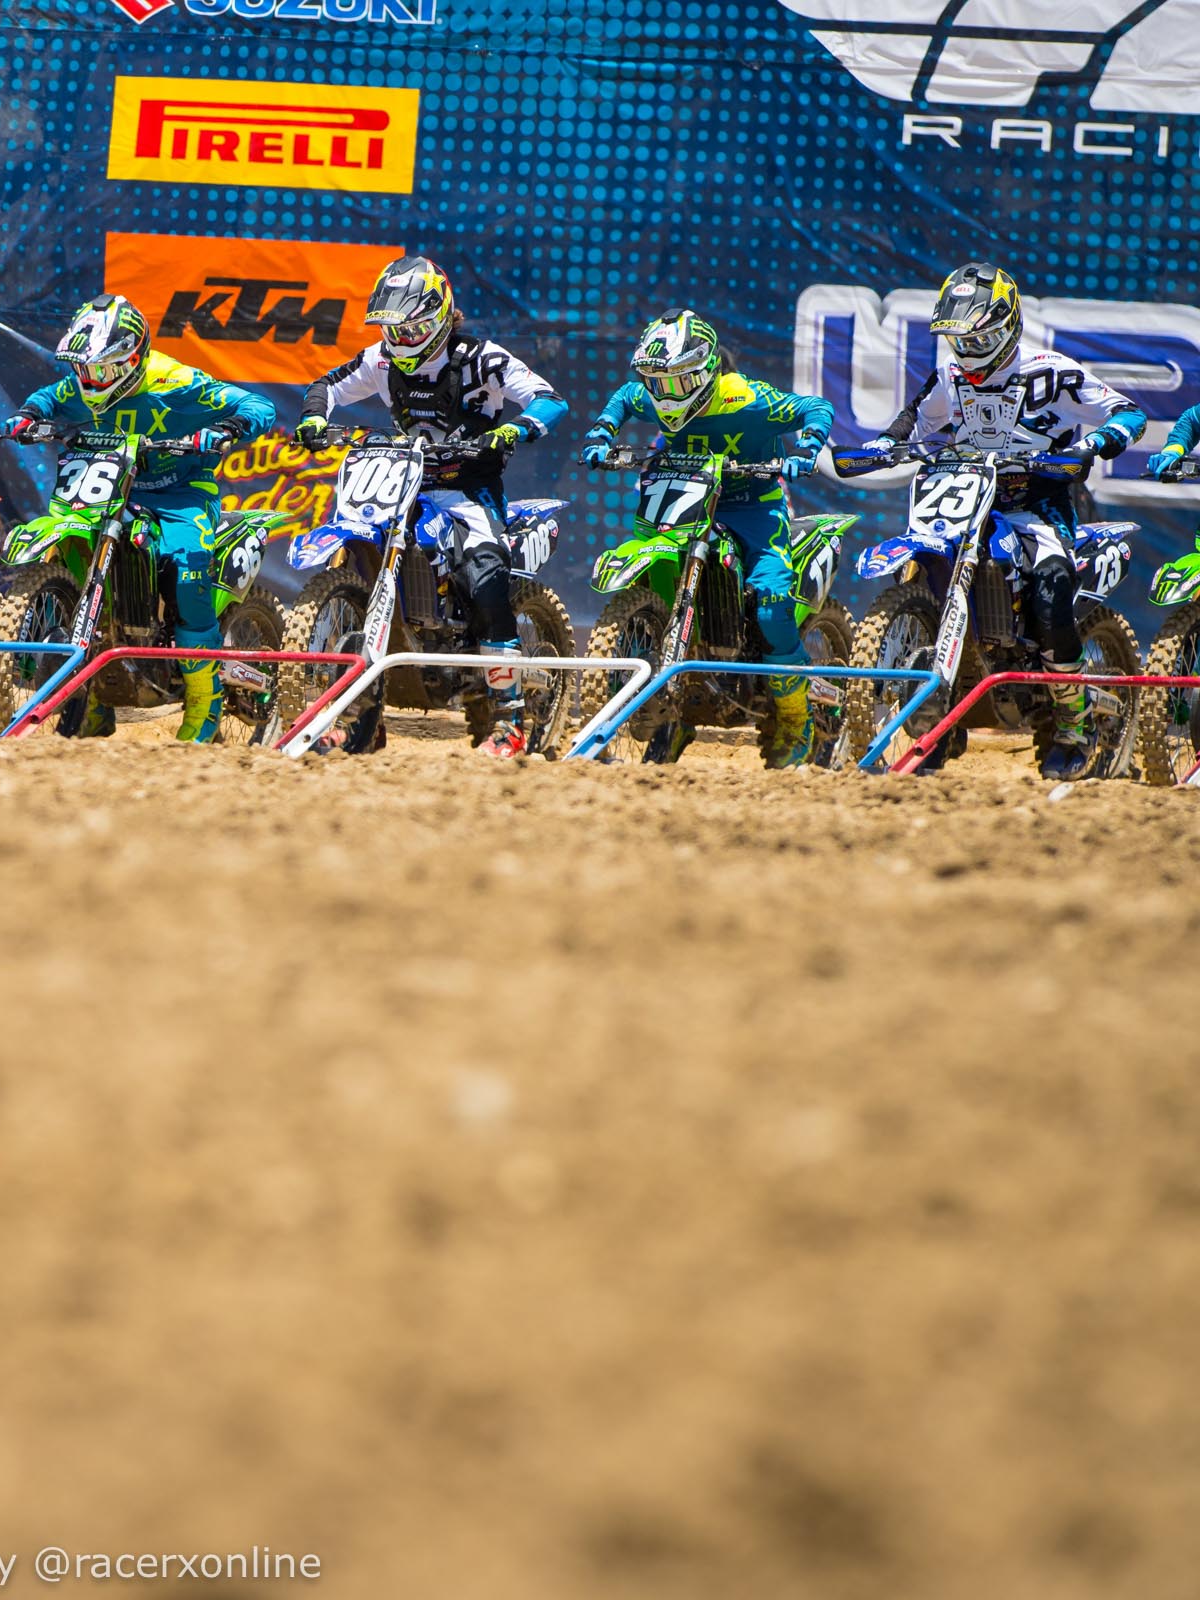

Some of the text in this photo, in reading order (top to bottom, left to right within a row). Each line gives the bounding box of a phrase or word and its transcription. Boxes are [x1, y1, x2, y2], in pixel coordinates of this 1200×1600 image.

[135, 99, 390, 169] PIRELLI
[157, 276, 348, 346] KTM
[94, 452, 107, 460] OIL
[365, 450, 398, 458] LUCAS OIL
[958, 464, 970, 473] OIL
[55, 460, 120, 504] 36
[342, 456, 417, 504] 108
[644, 479, 708, 525] 17
[914, 472, 981, 518] 23
[232, 536, 261, 589] 36
[520, 523, 550, 573] 108
[1095, 545, 1122, 596] 23
[182, 571, 202, 581] FOX
[367, 583, 389, 648] DUNLOP
[938, 598, 959, 664] DUNLOP
[955, 612, 967, 638] YAMALUBE
